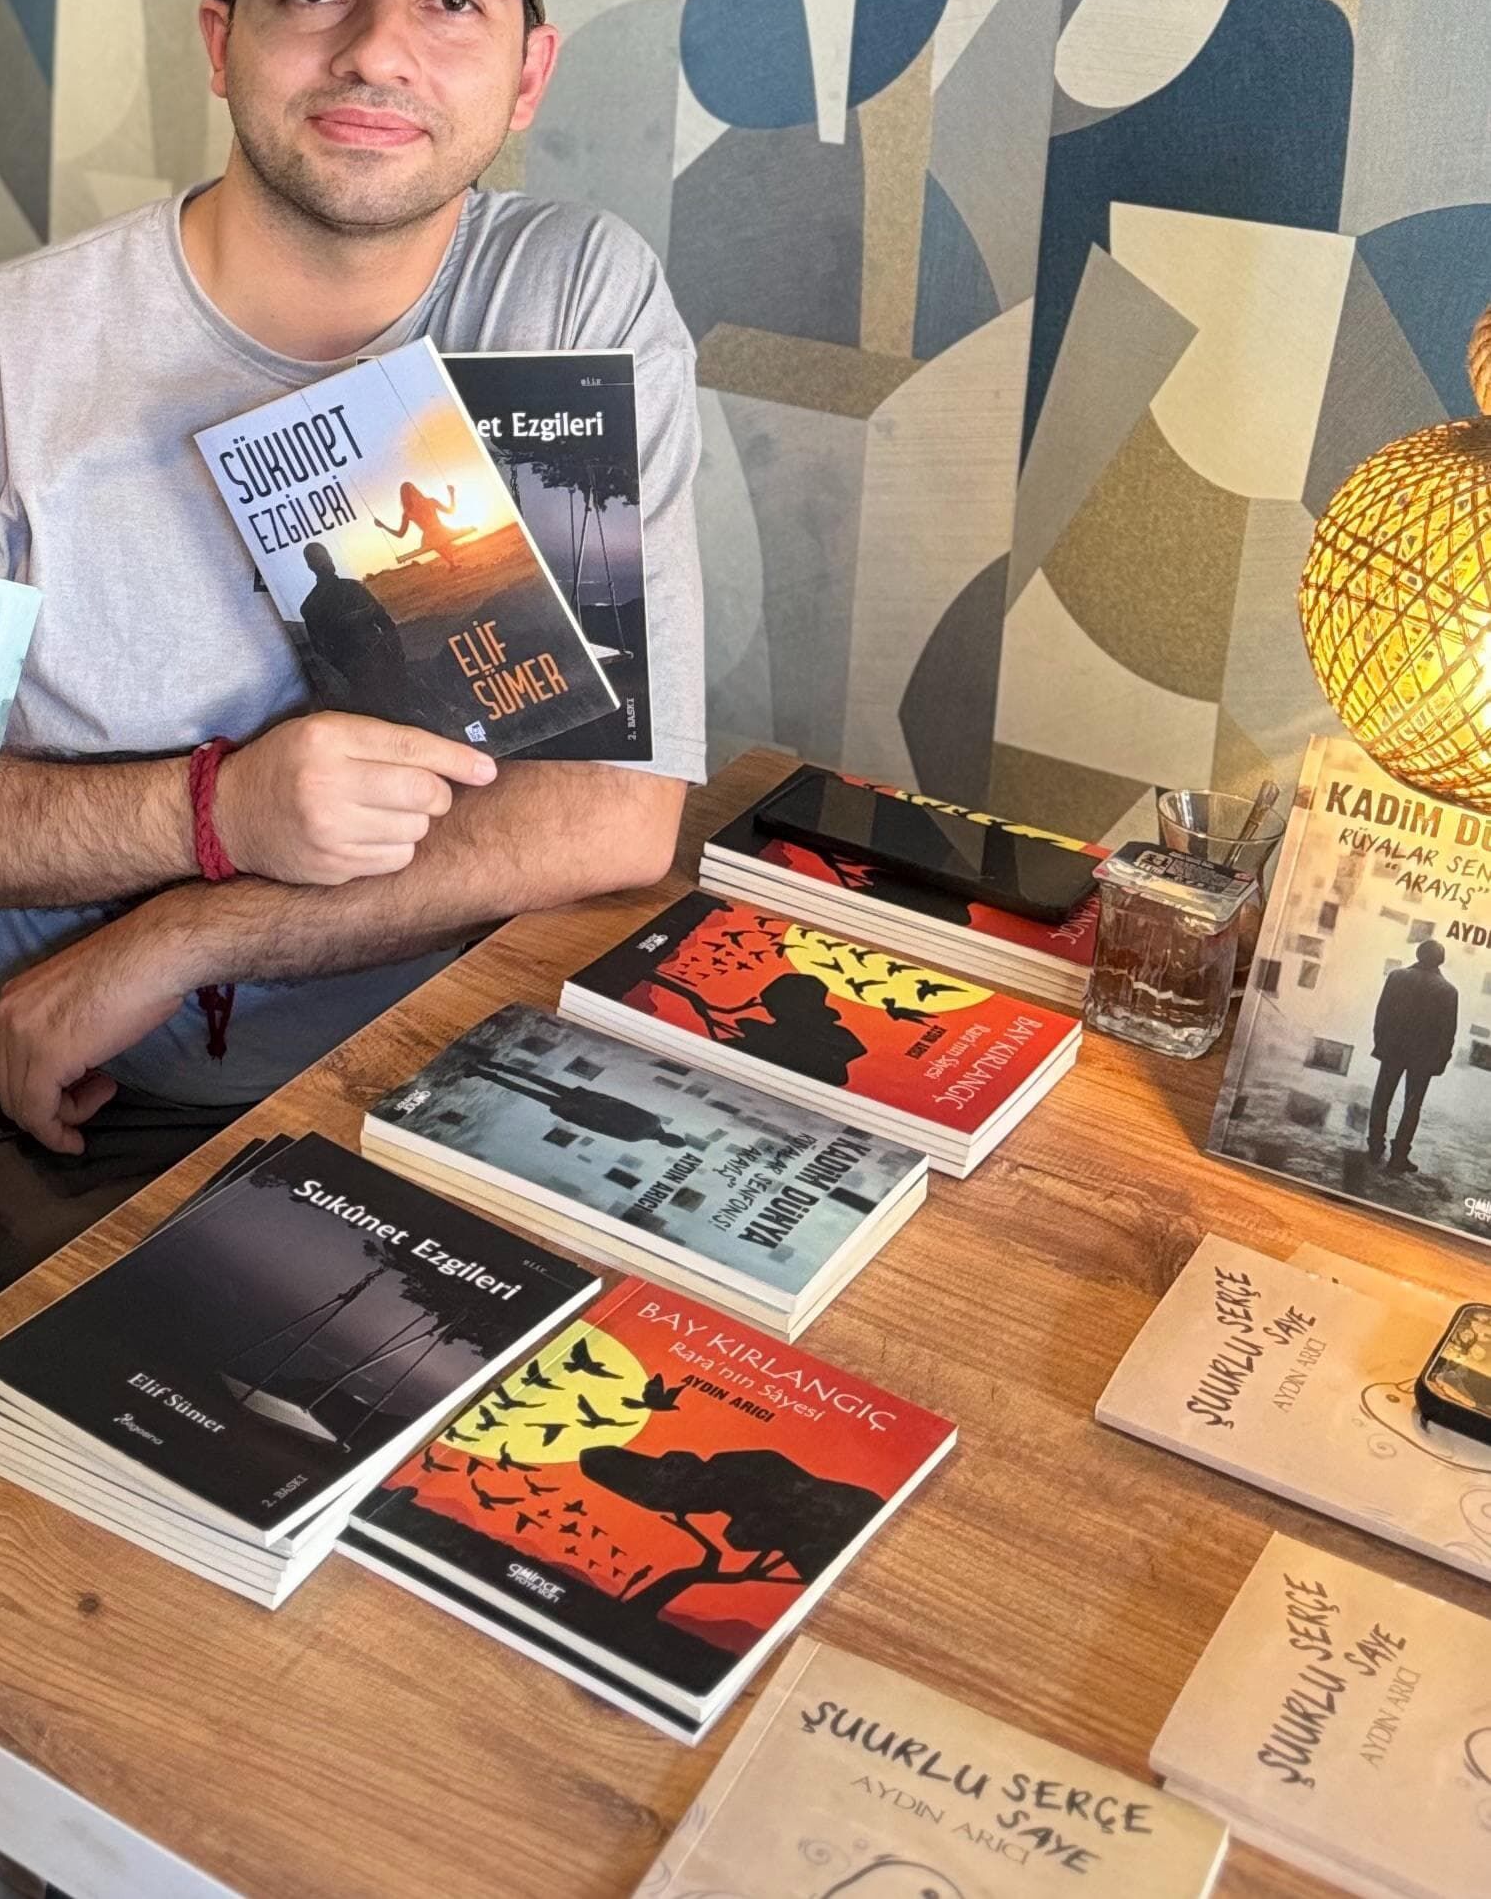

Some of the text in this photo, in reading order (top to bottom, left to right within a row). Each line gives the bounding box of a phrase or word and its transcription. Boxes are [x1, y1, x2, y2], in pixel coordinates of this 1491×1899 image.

[512, 411, 604, 442] Ezgileri
[448, 620, 507, 678] ELİF
[472, 652, 569, 721] SÜMER
[1325, 781, 1442, 839] KADİM
[1338, 826, 1440, 870] RÜYALAR
[932, 1015, 1044, 1110] BAY KIRLANGIÇ
[662, 1152, 704, 1184] AYDIN
[737, 1136, 872, 1249] KADİM DÜNYA
[293, 1180, 523, 1301] Sukûnet Ezgileri
[1186, 1266, 1264, 1430] ŞUURLU SERÇE
[1262, 1305, 1317, 1346] SAYE
[637, 1301, 897, 1432] BAY KIRLANGIÇ
[680, 1374, 776, 1424] AYDIN ARICI
[1271, 1336, 1327, 1415] AYDIN ARICI
[127, 1372, 172, 1398] Elif
[163, 1393, 226, 1434] Sümer
[758, 1381, 826, 1422] Sâyesi
[273, 1474, 309, 1500] BASKI
[1257, 1572, 1348, 1790] ŞUURLU SERÇE
[1343, 1622, 1407, 1677] SAYE
[1359, 1666, 1422, 1771] AYDIN ARICI
[801, 1701, 1154, 1834] ŞUURLU SERÇE
[850, 1775, 1030, 1867] AYDIN ARICI
[996, 1809, 1101, 1875] SAYE
